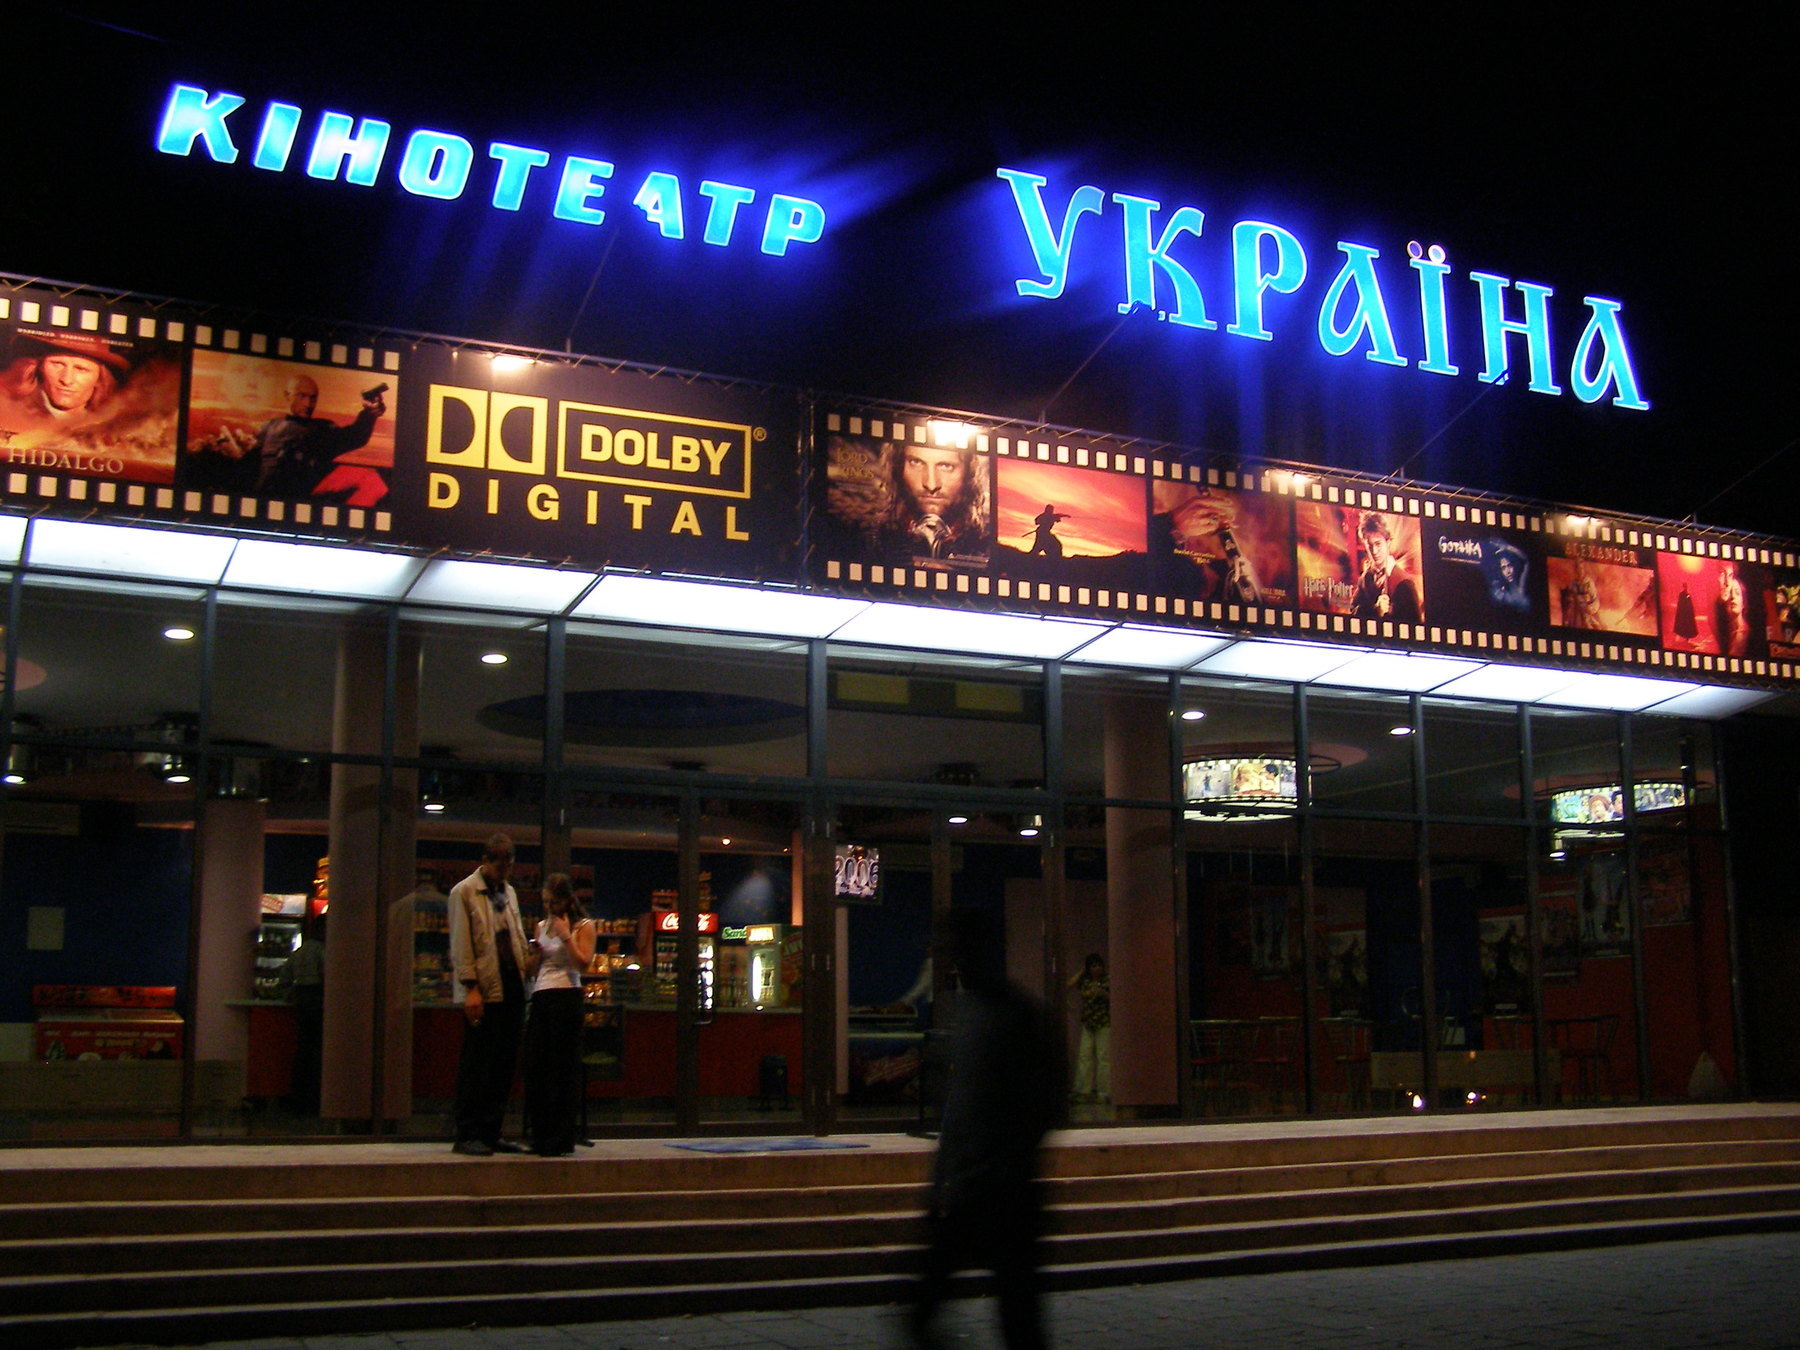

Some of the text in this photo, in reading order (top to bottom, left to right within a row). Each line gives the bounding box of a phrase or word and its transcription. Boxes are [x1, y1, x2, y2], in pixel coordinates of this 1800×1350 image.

[158, 84, 826, 257] КІНОТЕАТР
[997, 168, 1650, 411] УКРАЇНА
[8, 447, 124, 474] HIDALGO
[580, 423, 731, 475] DOLBY
[427, 472, 749, 541] DIGITAL
[1564, 541, 1638, 566] ALEXANDER
[1328, 577, 1354, 603] Potter
